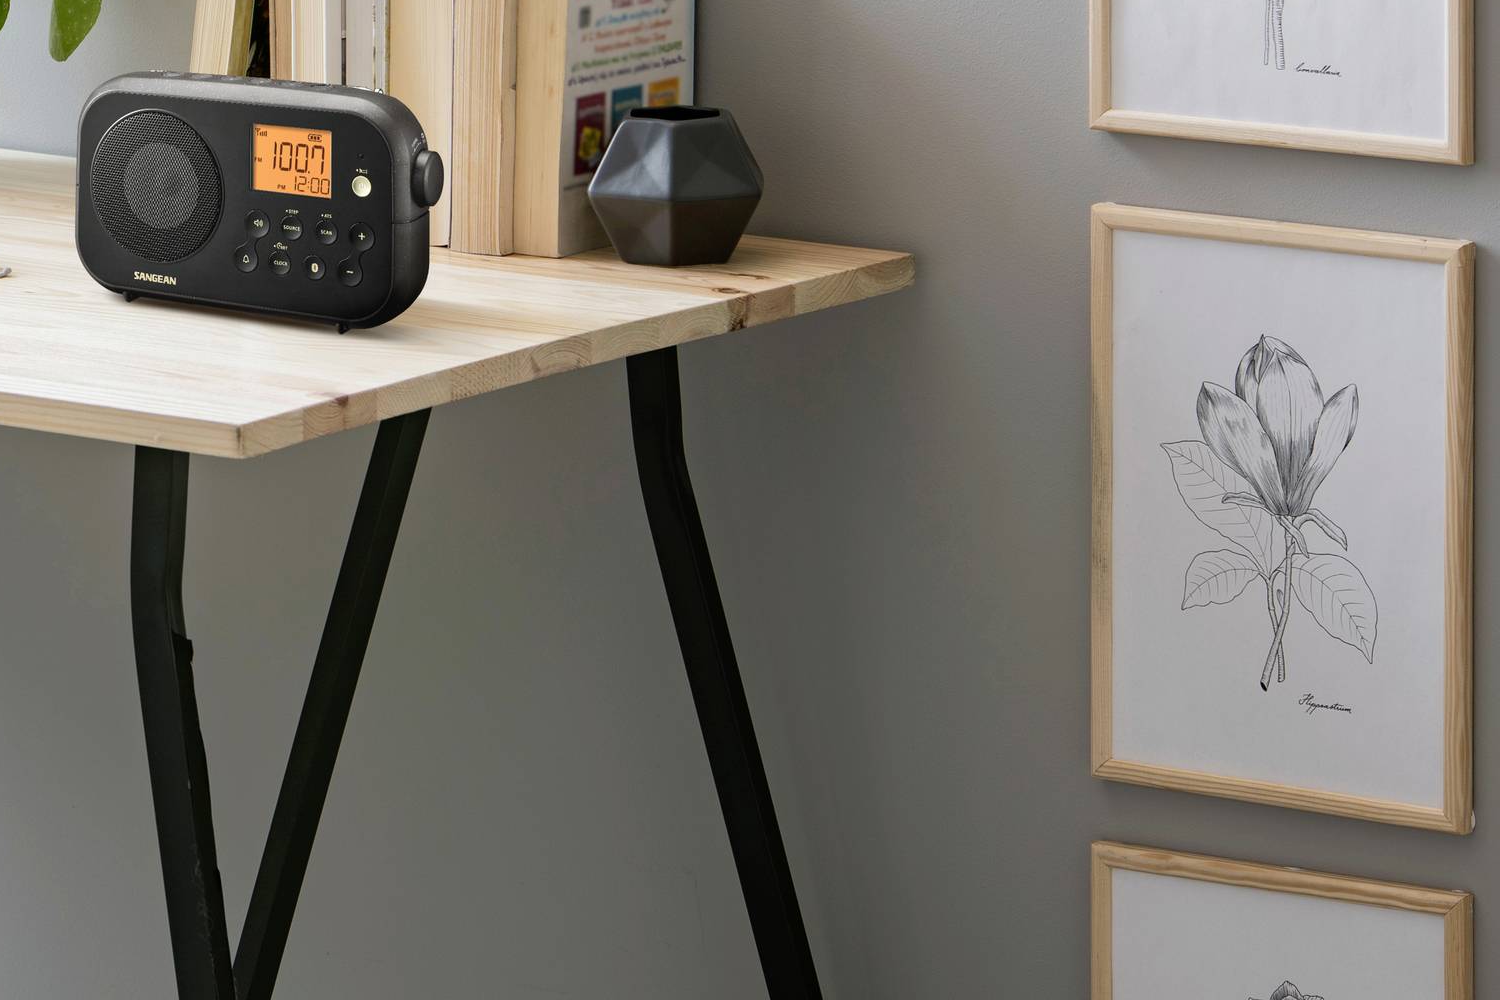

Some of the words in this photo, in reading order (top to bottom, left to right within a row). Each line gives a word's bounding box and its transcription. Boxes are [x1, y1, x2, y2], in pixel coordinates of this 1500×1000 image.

[273, 141, 325, 175] 100.7
[294, 175, 331, 194] 12:00
[283, 224, 301, 232] SOURCE
[273, 259, 288, 267] CLOCK
[133, 271, 177, 285] SANGEAN
